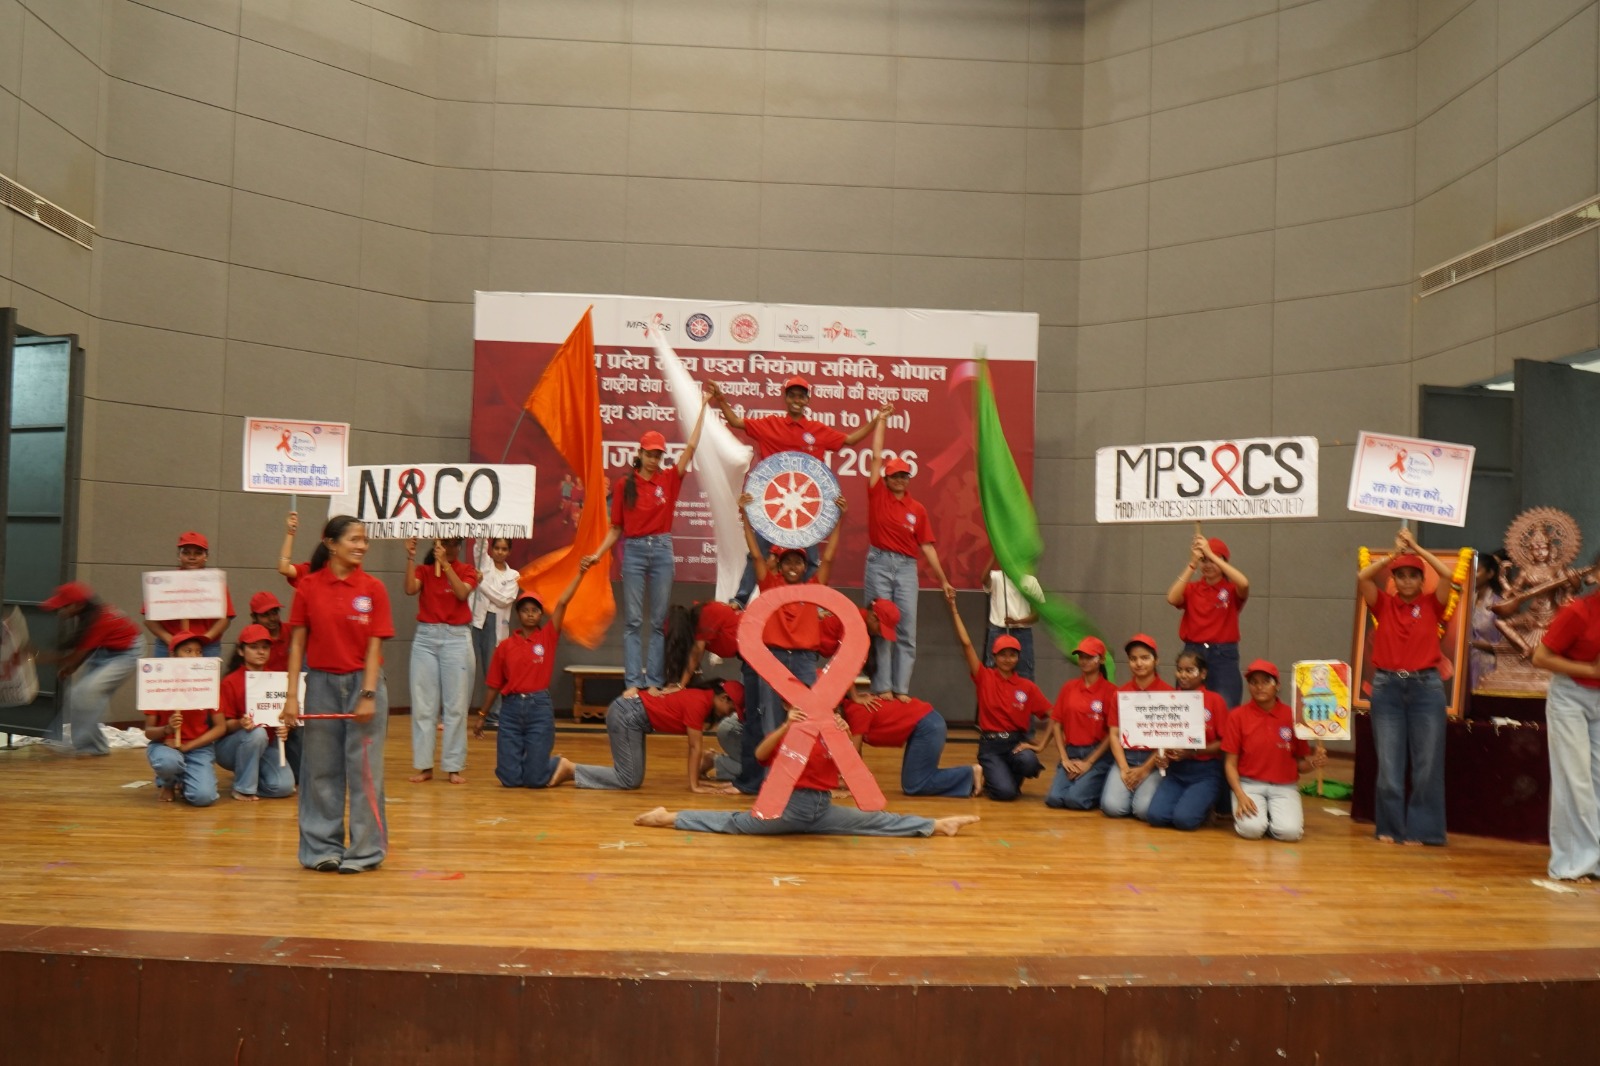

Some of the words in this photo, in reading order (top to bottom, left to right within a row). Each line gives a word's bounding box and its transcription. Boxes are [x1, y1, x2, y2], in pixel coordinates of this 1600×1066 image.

[606, 349, 651, 370] प्रदेश
[702, 357, 745, 376] एड्स
[748, 353, 817, 376] नियंत्रण
[820, 357, 884, 381] समिति,
[890, 359, 947, 381] भोपाल
[601, 373, 638, 394] राष्ट्रीय
[639, 374, 663, 393] सेवा
[766, 378, 782, 397] रेड
[847, 381, 864, 400] की
[866, 384, 901, 406] संयुक्त
[901, 387, 929, 403] पहल
[599, 404, 624, 425] यूथ
[840, 410, 860, 427] to
[357, 467, 501, 520] NACO
[1389, 485, 1400, 496] का
[1387, 499, 1398, 509] का
[400, 521, 420, 539] AIDS
